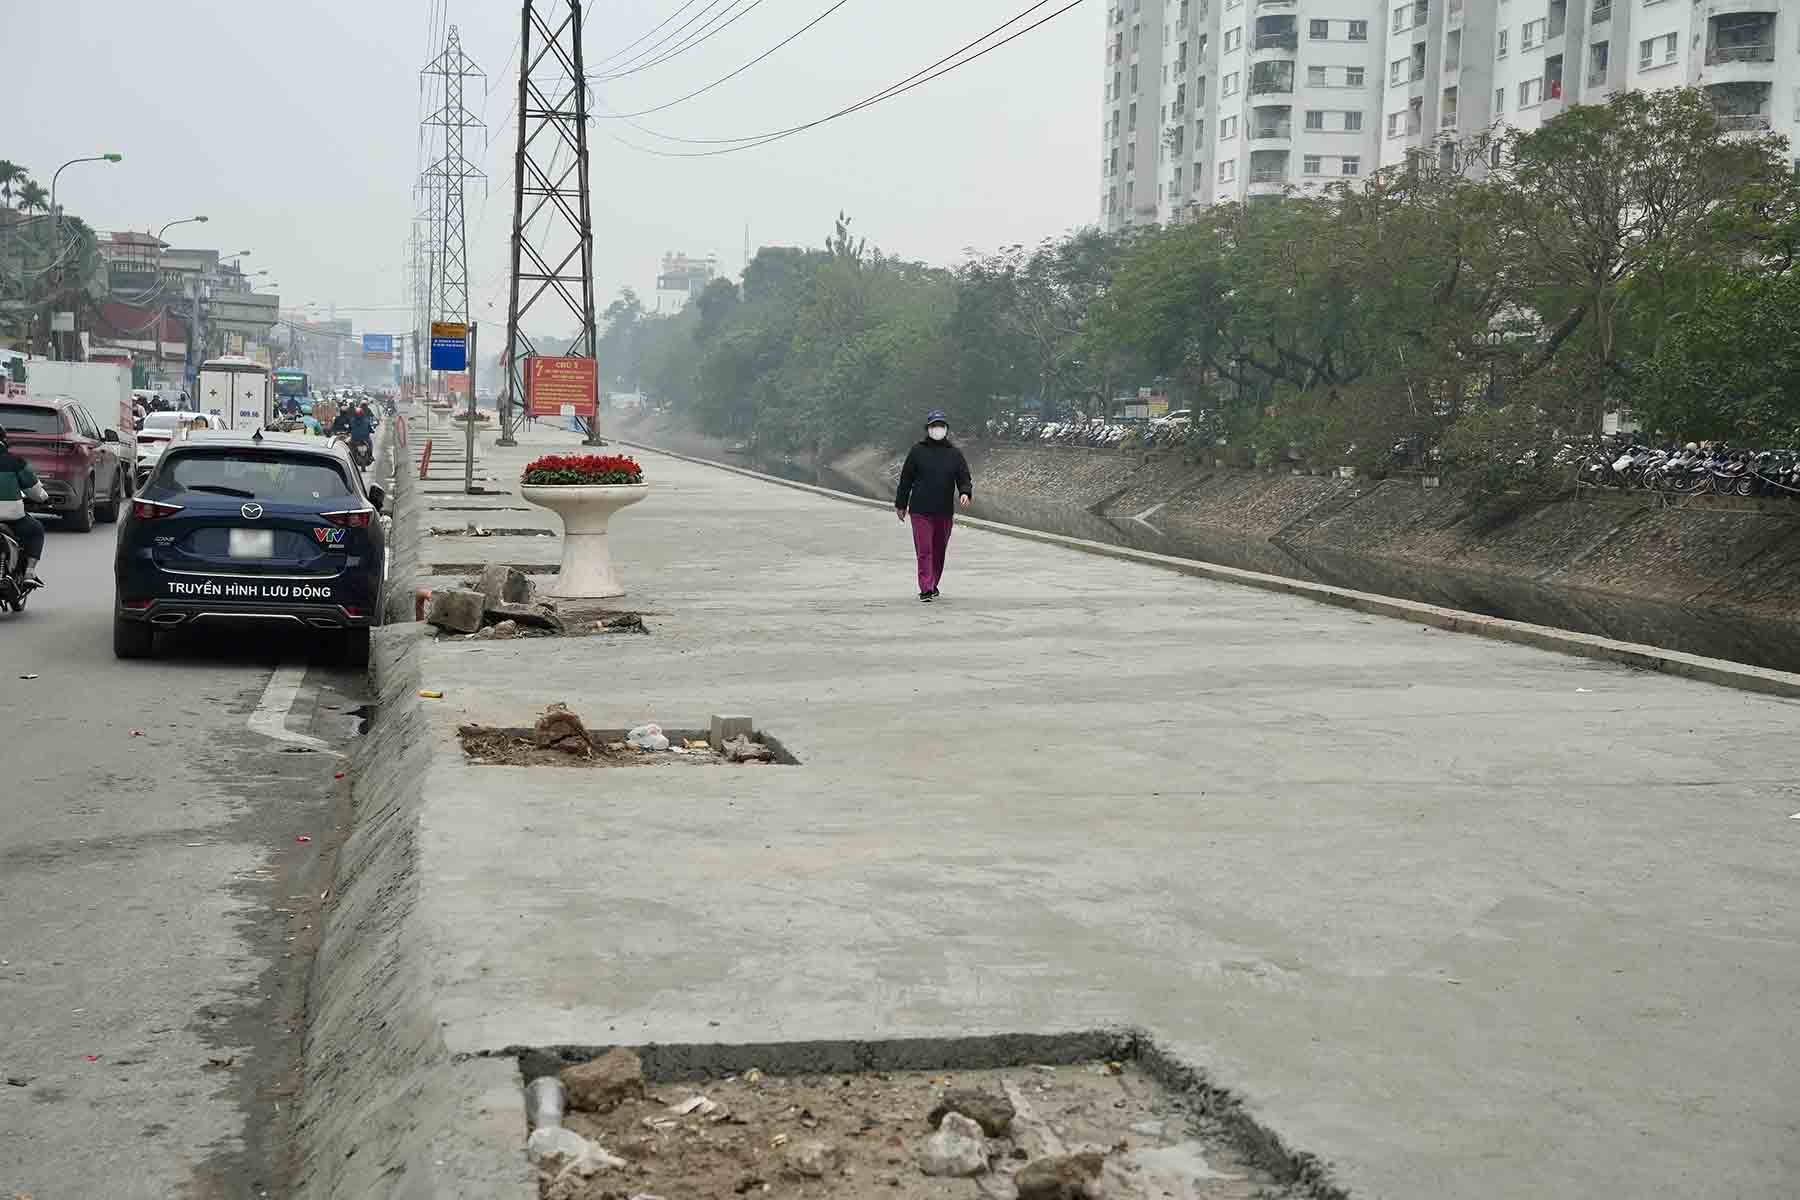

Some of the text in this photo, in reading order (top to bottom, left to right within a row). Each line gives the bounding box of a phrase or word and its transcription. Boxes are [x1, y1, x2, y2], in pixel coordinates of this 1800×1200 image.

[313, 527, 346, 543] VTV
[168, 580, 331, 599] TRUYỀN HÌNH LƯU ĐỘNG
